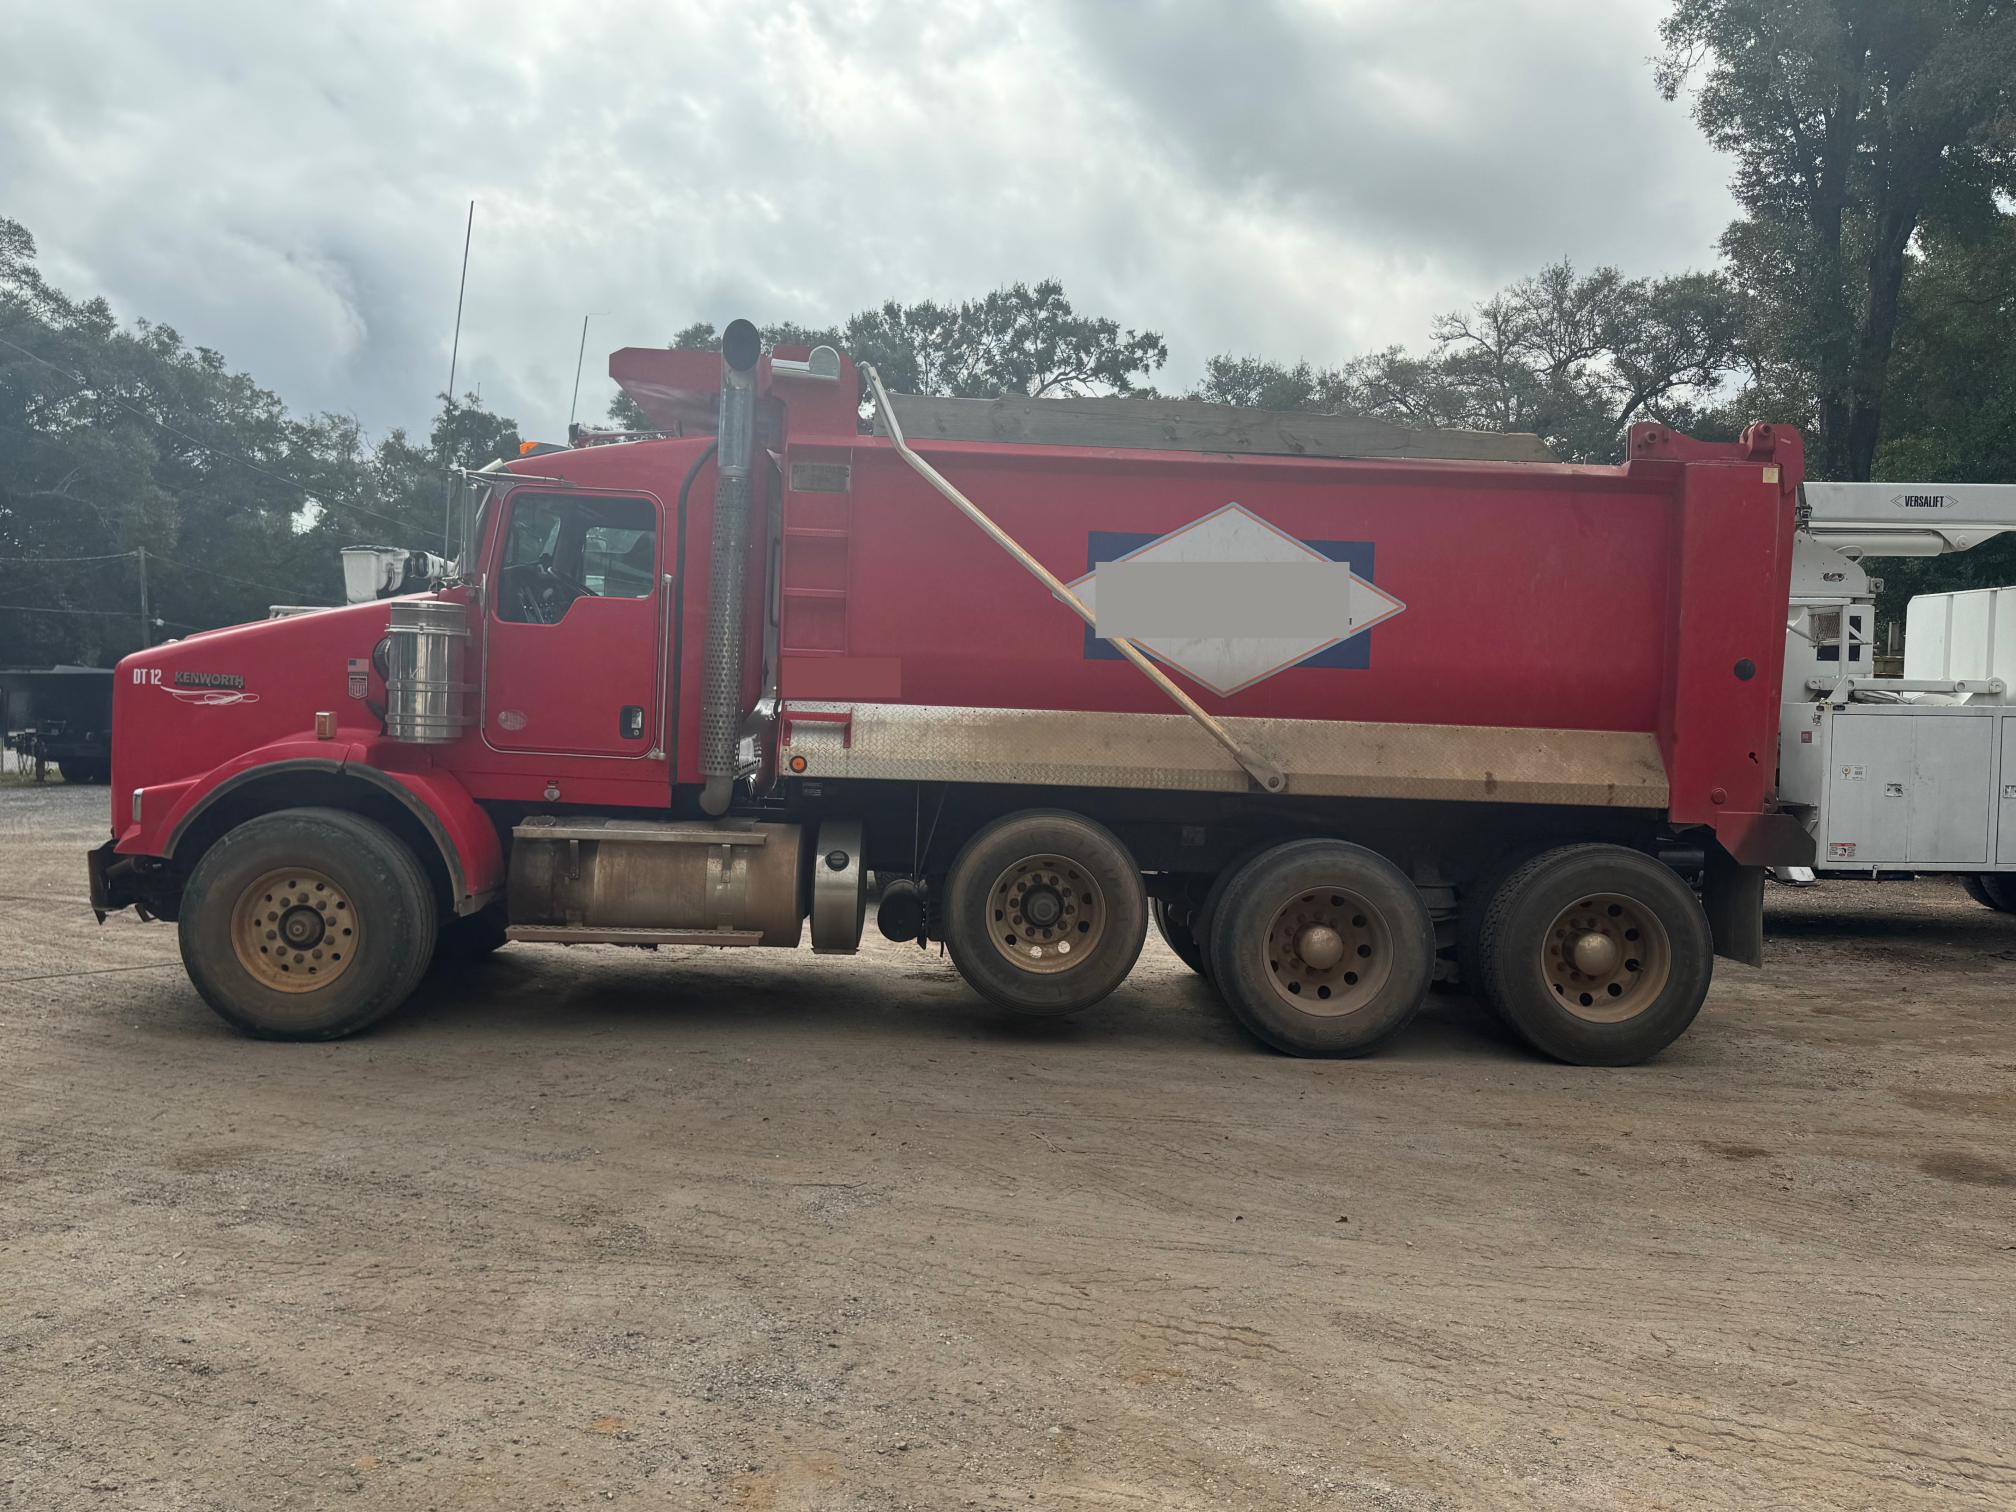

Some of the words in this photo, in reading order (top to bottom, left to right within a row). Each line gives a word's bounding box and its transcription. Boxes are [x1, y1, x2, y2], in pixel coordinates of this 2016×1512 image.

[1904, 495, 1945, 508] VERSALIFT
[133, 668, 148, 685] DT
[150, 668, 162, 685] 12
[175, 671, 245, 688] KENWORTH
